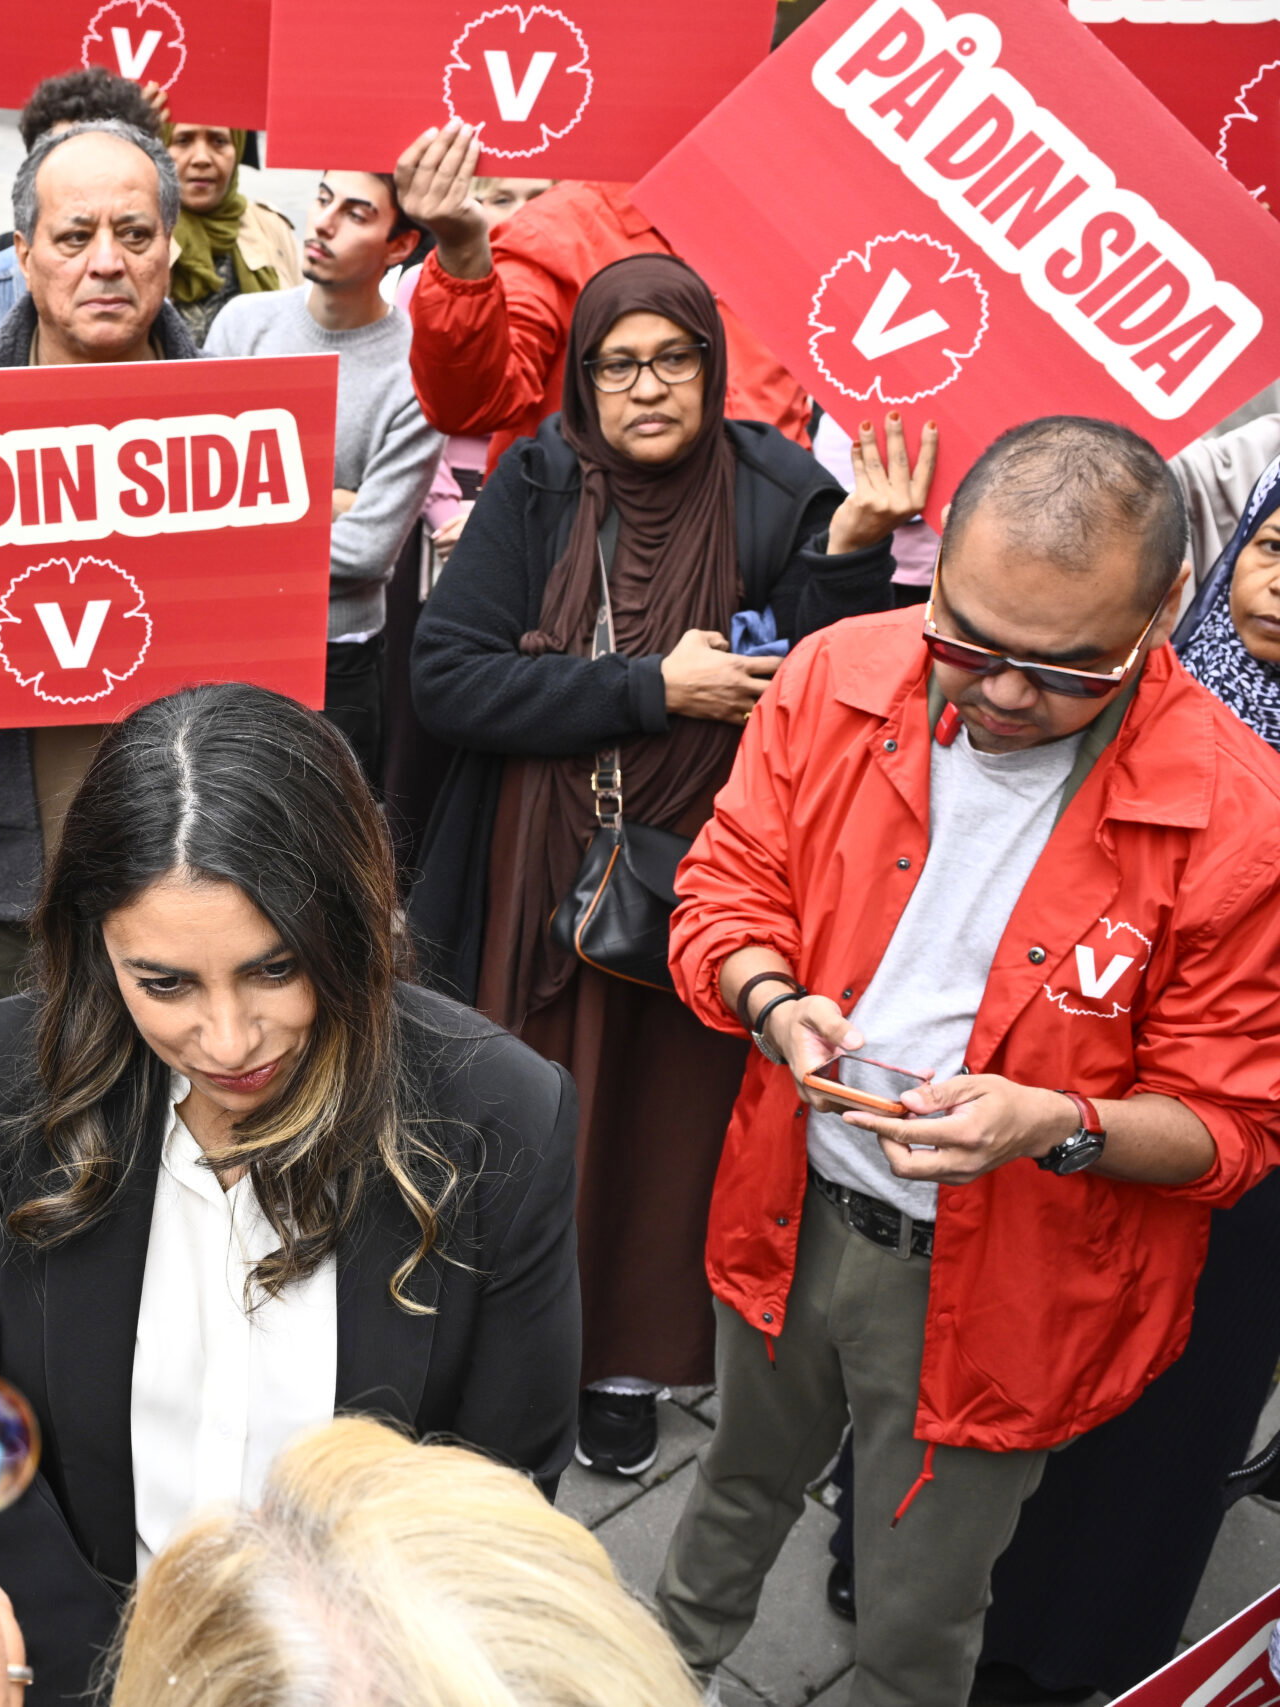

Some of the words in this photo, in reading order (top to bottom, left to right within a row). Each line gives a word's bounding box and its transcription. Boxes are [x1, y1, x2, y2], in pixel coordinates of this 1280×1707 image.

[111, 27, 163, 80] V
[483, 49, 558, 122] V
[836, 7, 977, 142] PÅ
[924, 94, 1090, 251] DIN
[1044, 211, 1236, 397] SIDA
[851, 267, 951, 361] V
[117, 429, 290, 518] SIDA
[34, 600, 112, 669] V
[1075, 944, 1135, 999] V
